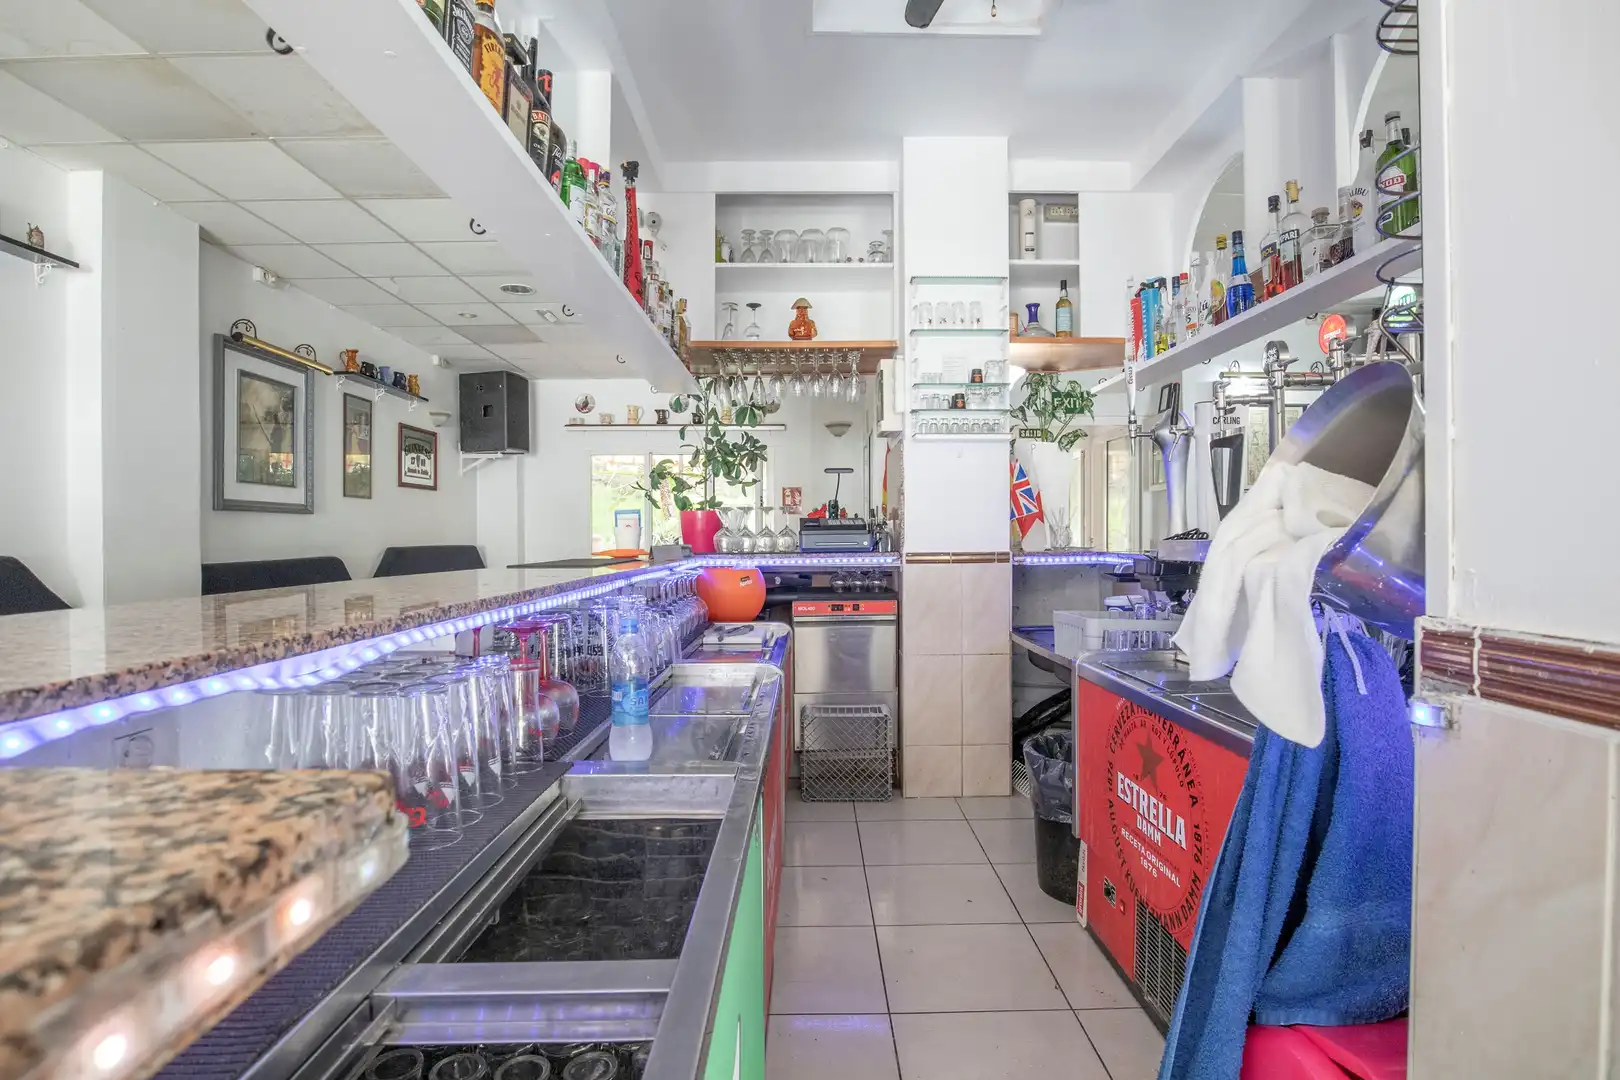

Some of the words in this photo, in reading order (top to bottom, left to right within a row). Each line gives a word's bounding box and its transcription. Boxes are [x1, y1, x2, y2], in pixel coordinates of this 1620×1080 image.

[1053, 397, 1082, 409] EXIT
[1117, 771, 1187, 850] ESTRELLA
[1136, 813, 1162, 847] DAMM
[1121, 827, 1146, 856] RECETA
[1145, 850, 1181, 888] ORIGINAL
[1140, 856, 1158, 880] 1876
